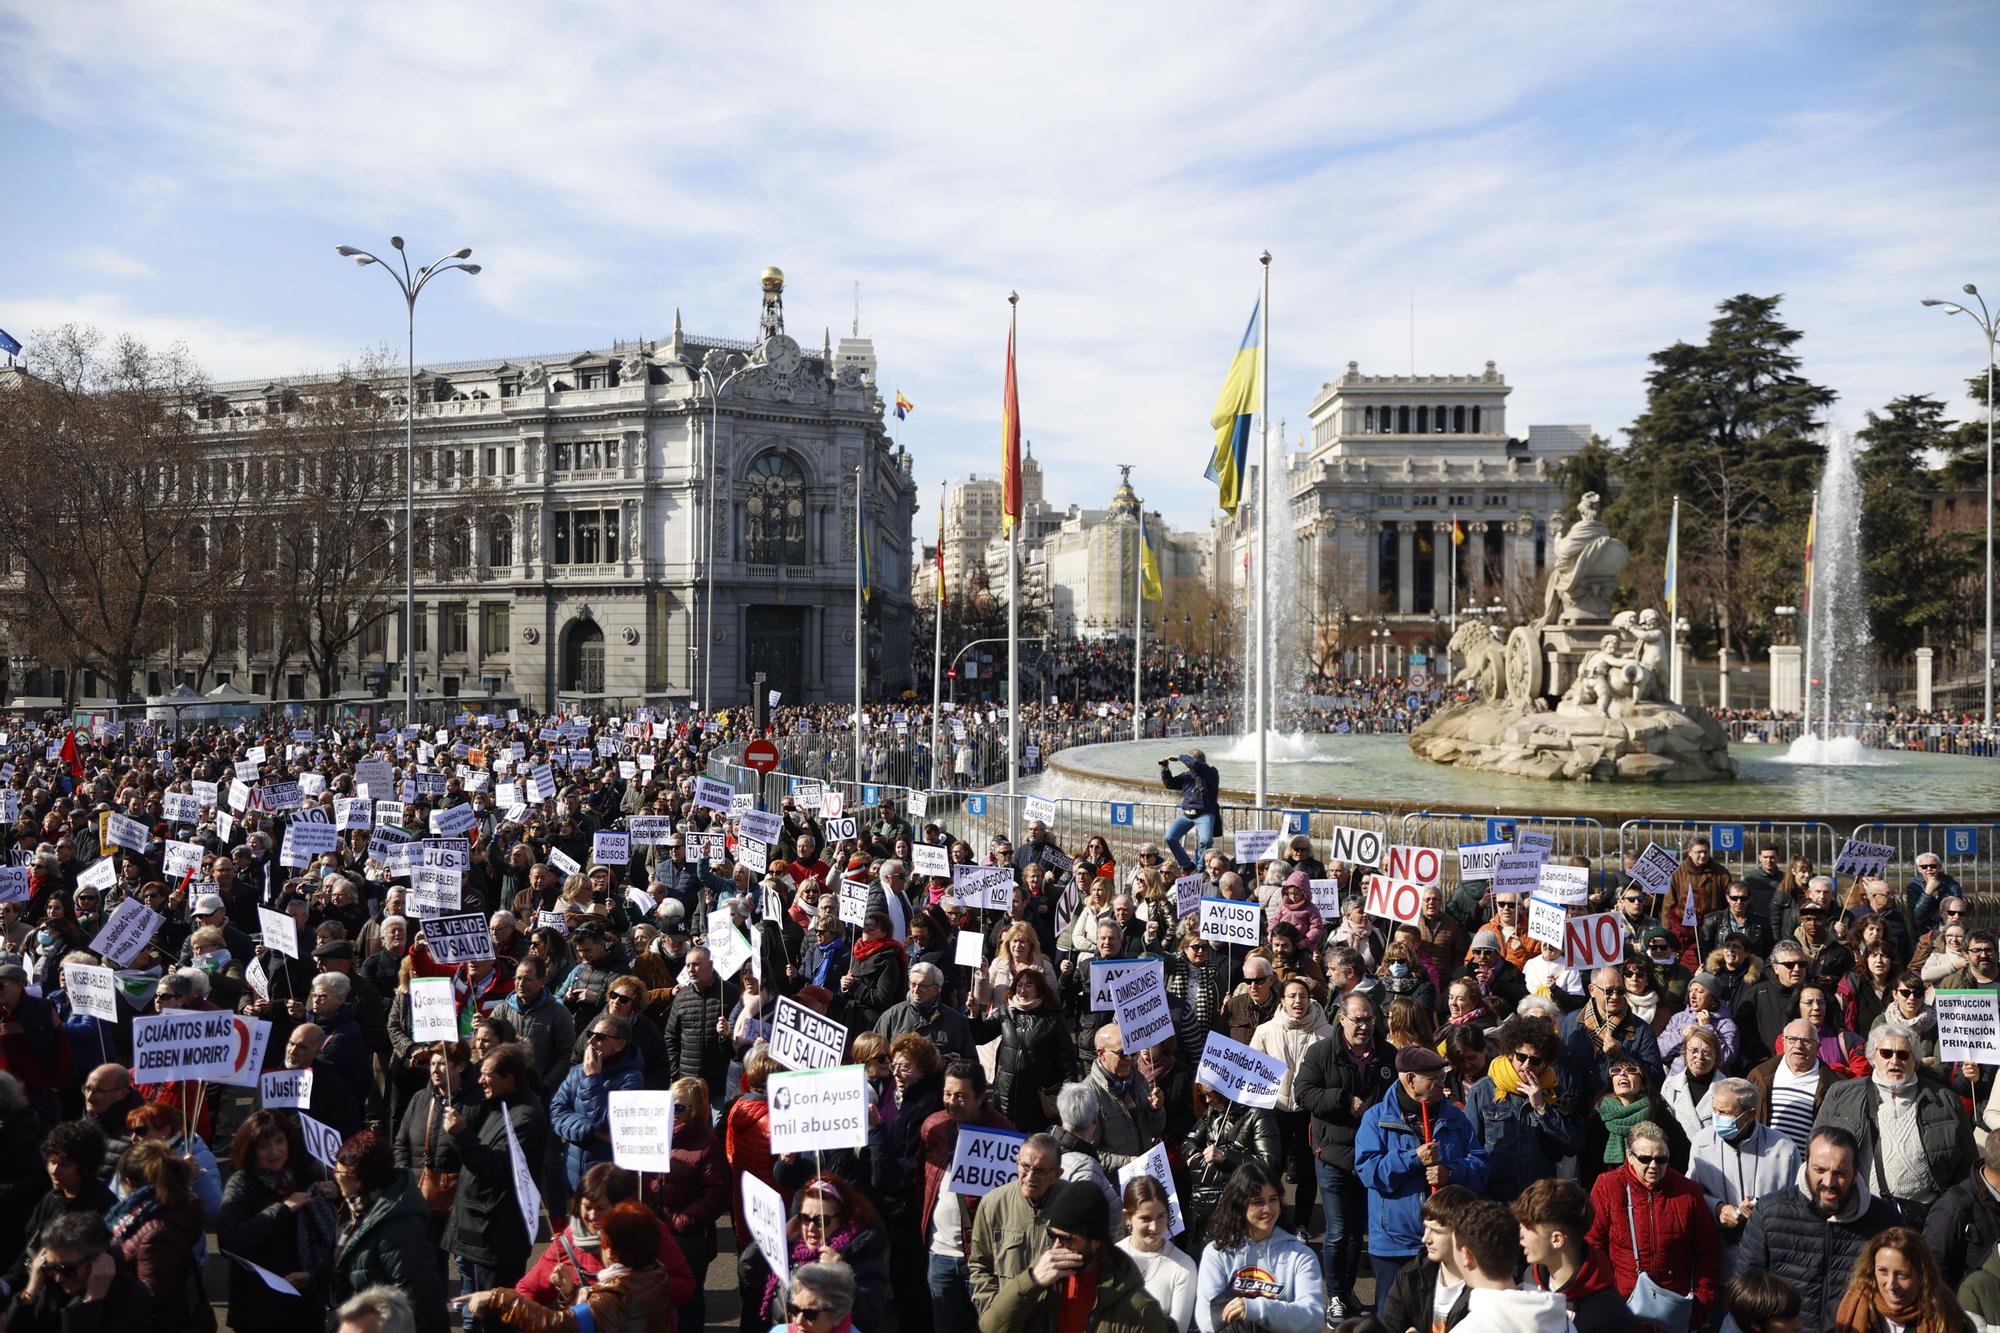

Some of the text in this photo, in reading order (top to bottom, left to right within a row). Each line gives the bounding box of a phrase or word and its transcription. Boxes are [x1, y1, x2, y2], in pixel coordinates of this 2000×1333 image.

[625, 723, 640, 737] NO
[264, 788, 273, 796] SE
[274, 783, 297, 794] VENDE
[266, 791, 297, 806] TU SALUD
[732, 798, 752, 808] OBAN
[821, 795, 842, 816] NO
[632, 830, 649, 839] DEBEN
[828, 820, 855, 840] NO
[437, 841, 466, 852] VENDE
[687, 834, 697, 845] SE
[1333, 828, 1380, 864] NO
[596, 850, 627, 860] ABUSOS.
[688, 846, 697, 858] TU
[1644, 847, 1658, 861] SE
[1857, 844, 1893, 858] SANIDAD
[425, 852, 460, 868] JUS-
[1390, 847, 1440, 883] NO
[954, 869, 1012, 900] SANIDAD-NEGOCIO
[1545, 872, 1566, 883] Sanidad
[990, 889, 1008, 901] NO!
[1177, 879, 1200, 901] ROBAN
[1367, 877, 1420, 922] NO
[1209, 906, 1254, 922] AY,USO
[108, 919, 129, 944] Sanidad
[426, 917, 484, 936] SE VENDE
[1202, 922, 1258, 940] ABUSOS.
[431, 935, 490, 958] TU SALUD
[1565, 914, 1620, 968] NO
[1116, 969, 1160, 1003] DIMISIONES:
[422, 996, 437, 1006] Con
[1123, 995, 1162, 1023] Por recortes
[1938, 999, 1991, 1008] DESTRUCCIÓN
[1940, 1012, 1994, 1022] PROGRAMADA
[137, 1016, 232, 1048] ¿CUÁNTOS MÁS
[779, 1003, 797, 1027] SE
[799, 1012, 844, 1051] VENDE
[1941, 1026, 1996, 1036] de ATENCIÓN
[776, 1028, 794, 1057] TU
[793, 1039, 838, 1069] SALUD
[1124, 1034, 1130, 1049] y
[1942, 1039, 1997, 1050] PRIMARIA.
[139, 1045, 230, 1070] DEBEN MORIR?
[1207, 1045, 1281, 1086] Una Sanidad Pública
[1202, 1058, 1279, 1096] gratuita y de calidad!
[264, 1074, 310, 1099] ¡Justicia!
[794, 1089, 860, 1106] Con Ayuso
[774, 1116, 863, 1136] mil abusos.
[301, 1114, 342, 1166] NO
[1233, 1279, 1280, 1294] Dickies
